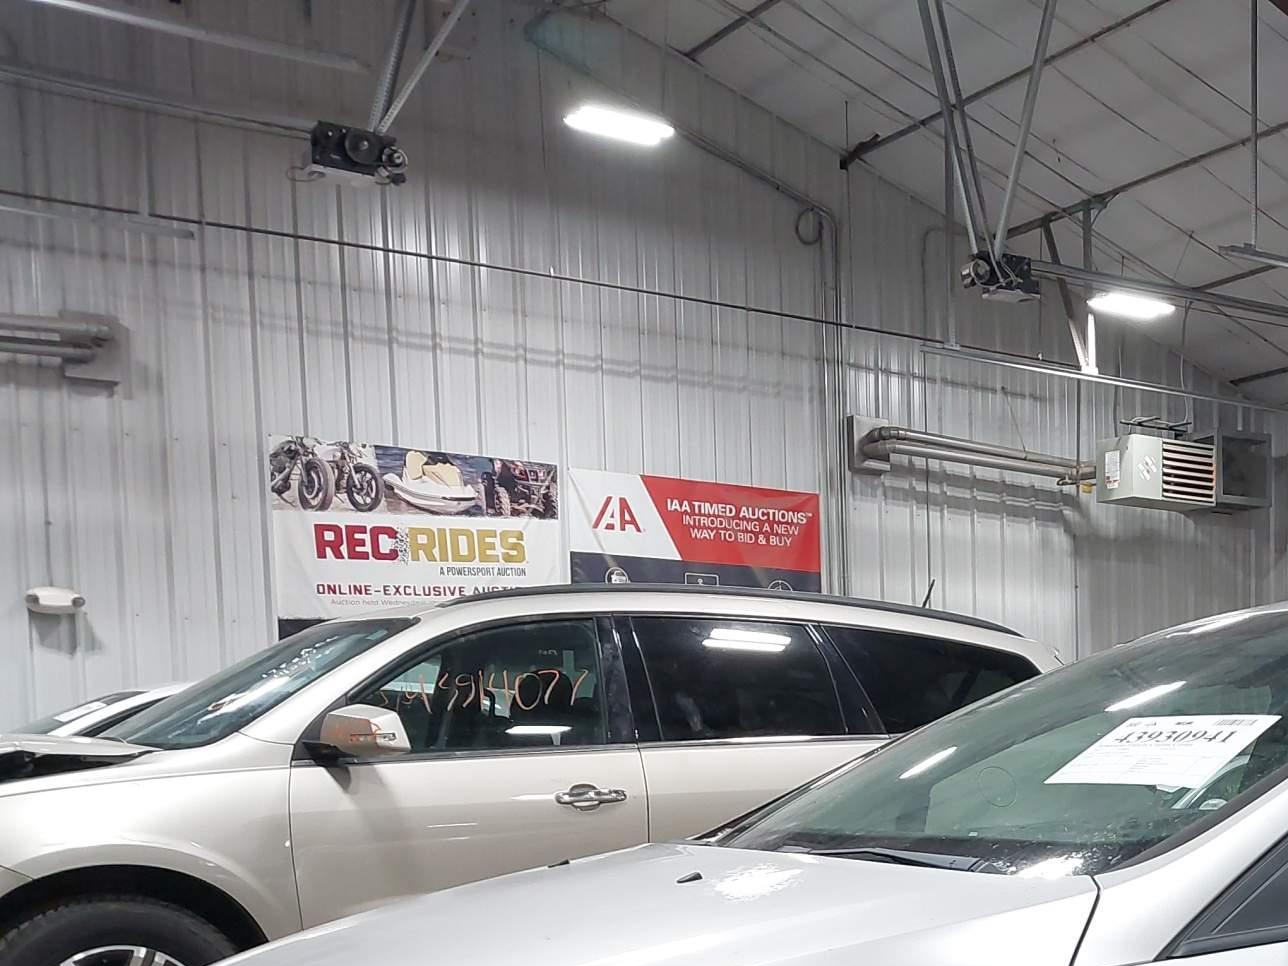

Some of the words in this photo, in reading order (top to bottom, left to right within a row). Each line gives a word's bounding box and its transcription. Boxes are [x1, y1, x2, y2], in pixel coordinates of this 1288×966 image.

[667, 498, 689, 513] IAA
[692, 500, 736, 517] TIMED
[682, 515, 760, 532] INTRODUCING
[762, 522, 770, 532] A
[773, 524, 799, 535] NEW
[314, 523, 399, 561] REC
[409, 527, 526, 563] RIDES
[690, 528, 716, 540] WAY
[719, 531, 734, 542] TO
[737, 533, 755, 544] BID
[757, 535, 767, 545] &
[769, 536, 793, 547] BUY
[439, 566, 445, 576] A
[446, 566, 495, 577] POWERSPORT
[497, 567, 527, 577] AUCTION
[316, 583, 465, 597] ONLINE-EXCLUSIVE
[1115, 730, 1237, 743] 43930941
